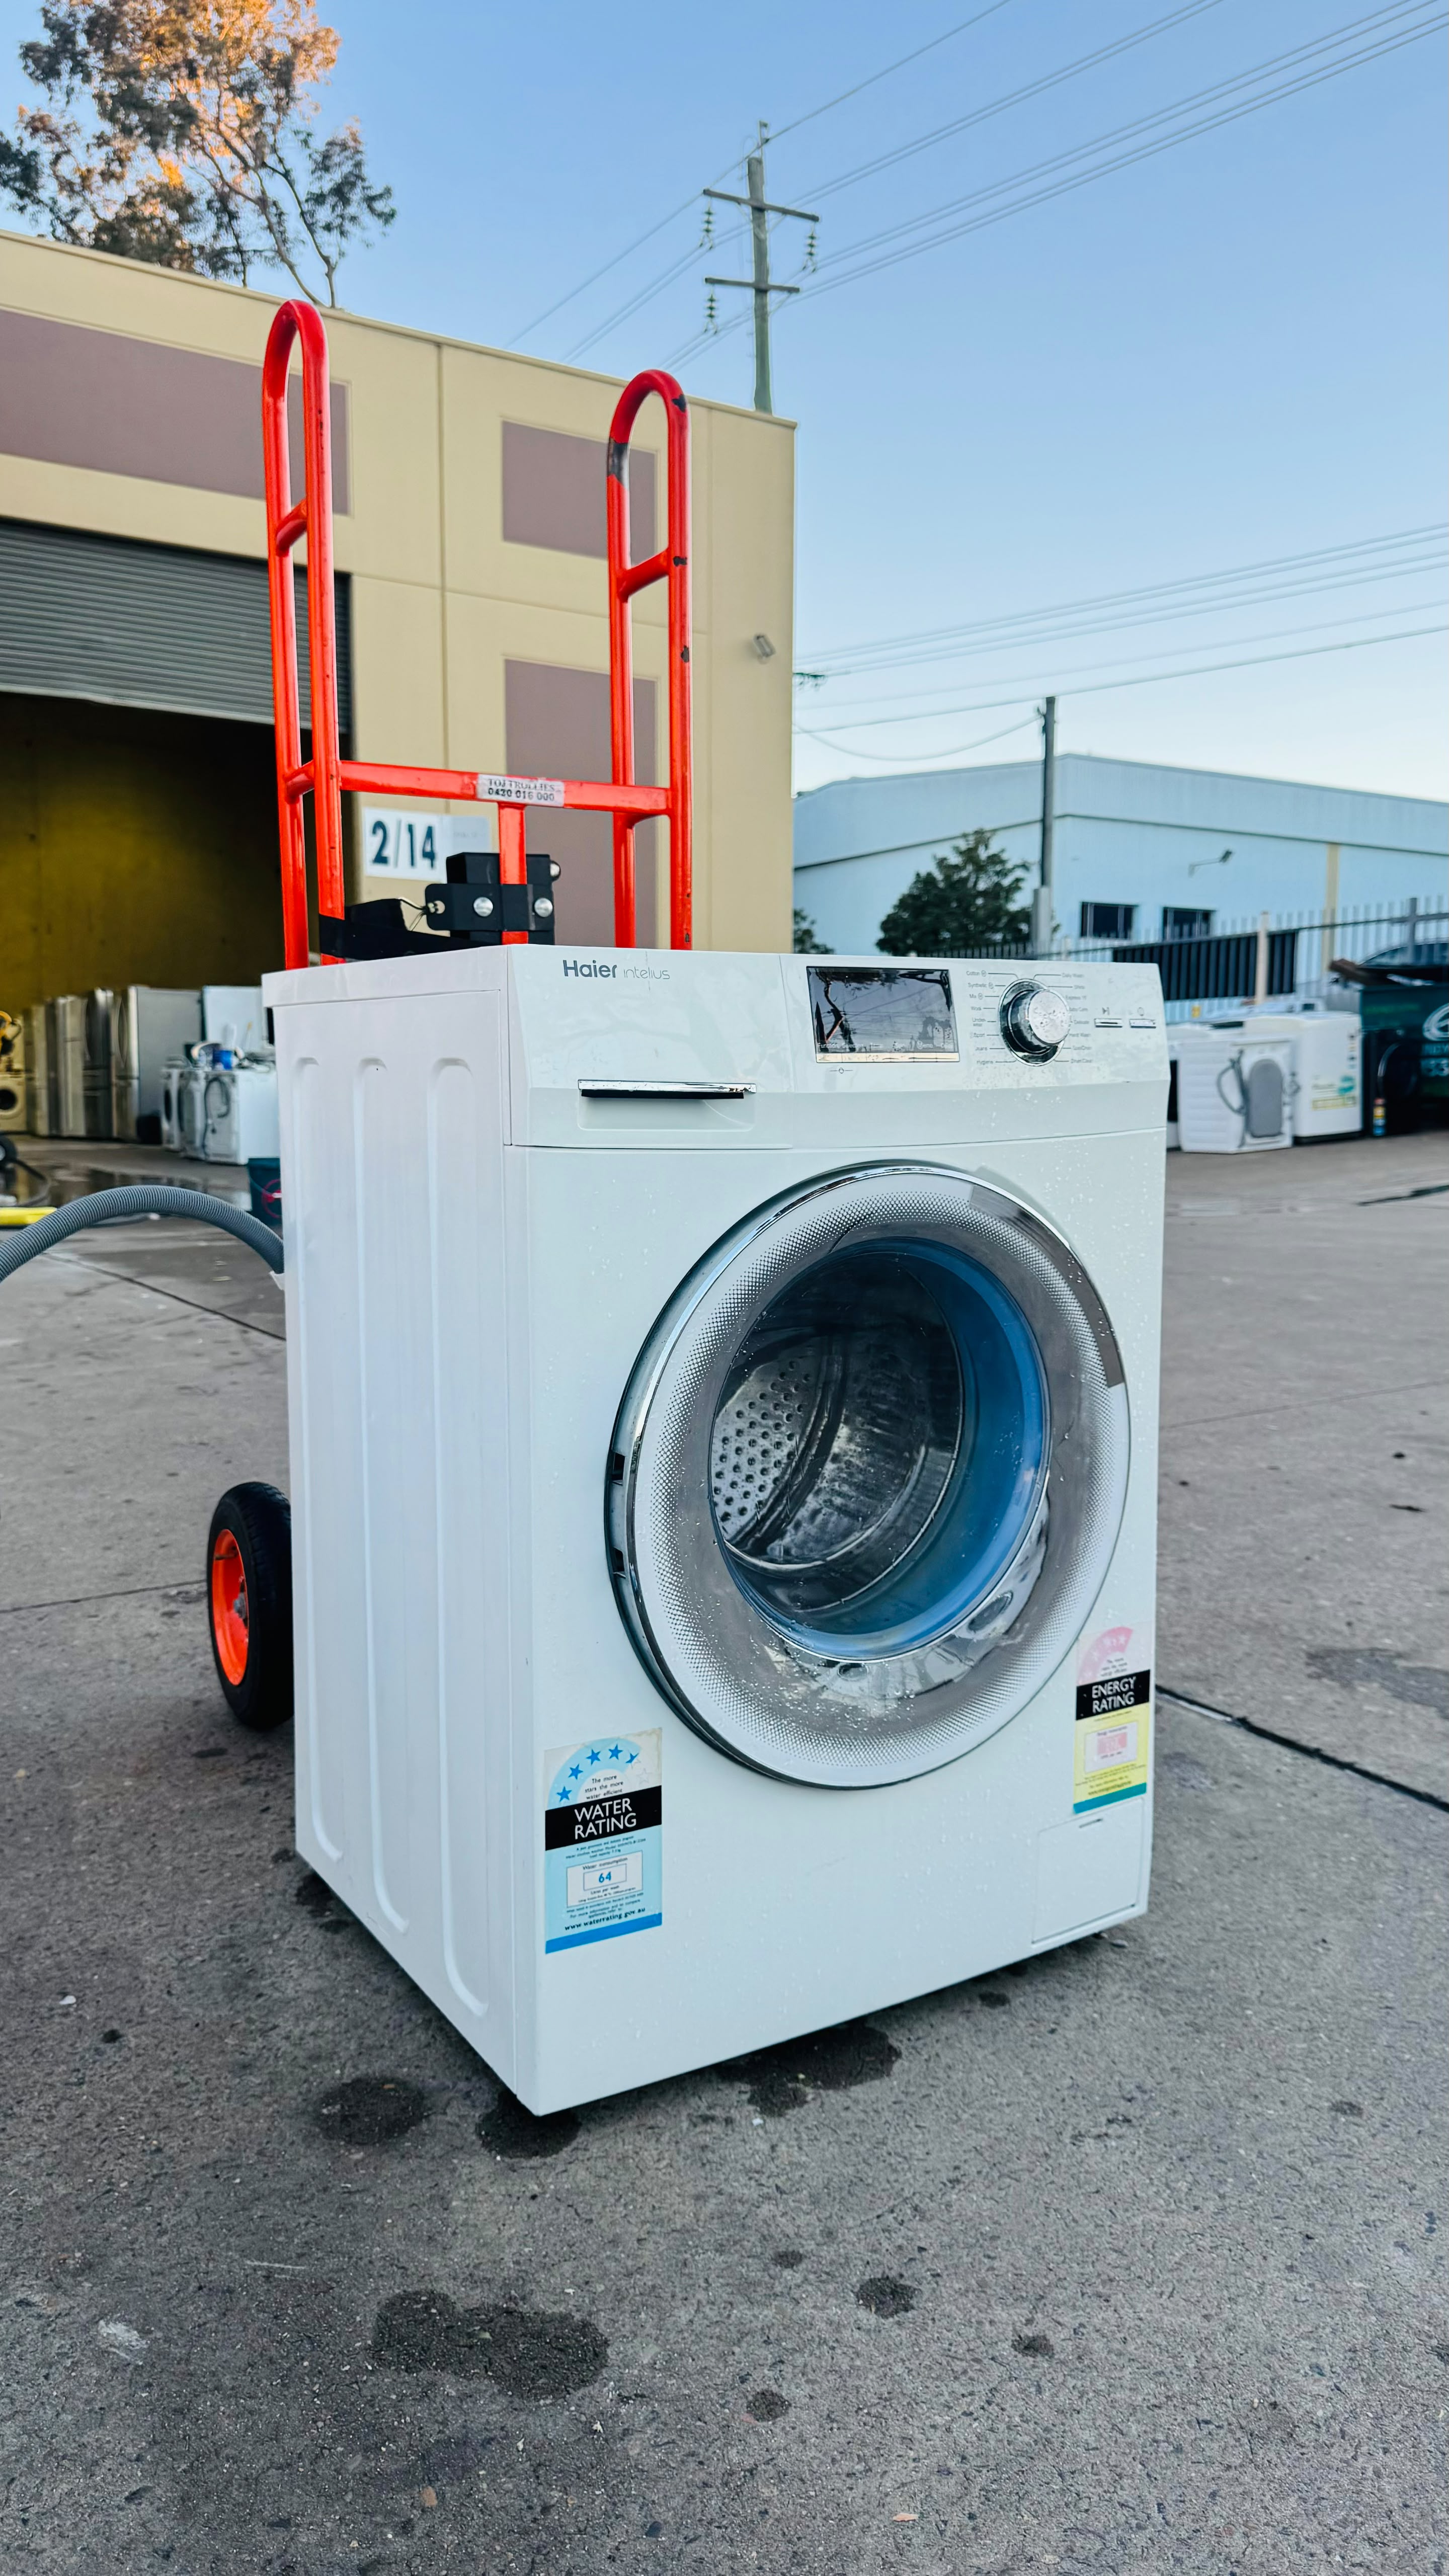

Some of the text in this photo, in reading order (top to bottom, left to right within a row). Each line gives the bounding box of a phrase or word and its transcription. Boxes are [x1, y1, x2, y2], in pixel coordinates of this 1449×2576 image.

[537, 792, 554, 801] 000
[372, 820, 436, 869] 2/14
[562, 959, 617, 978] Haier
[1092, 1676, 1136, 1699] ENERGY
[1092, 1692, 1135, 1714] RATING
[575, 1798, 632, 1822] WATER
[575, 1813, 637, 1840] RATING
[599, 1871, 611, 1883] 64
